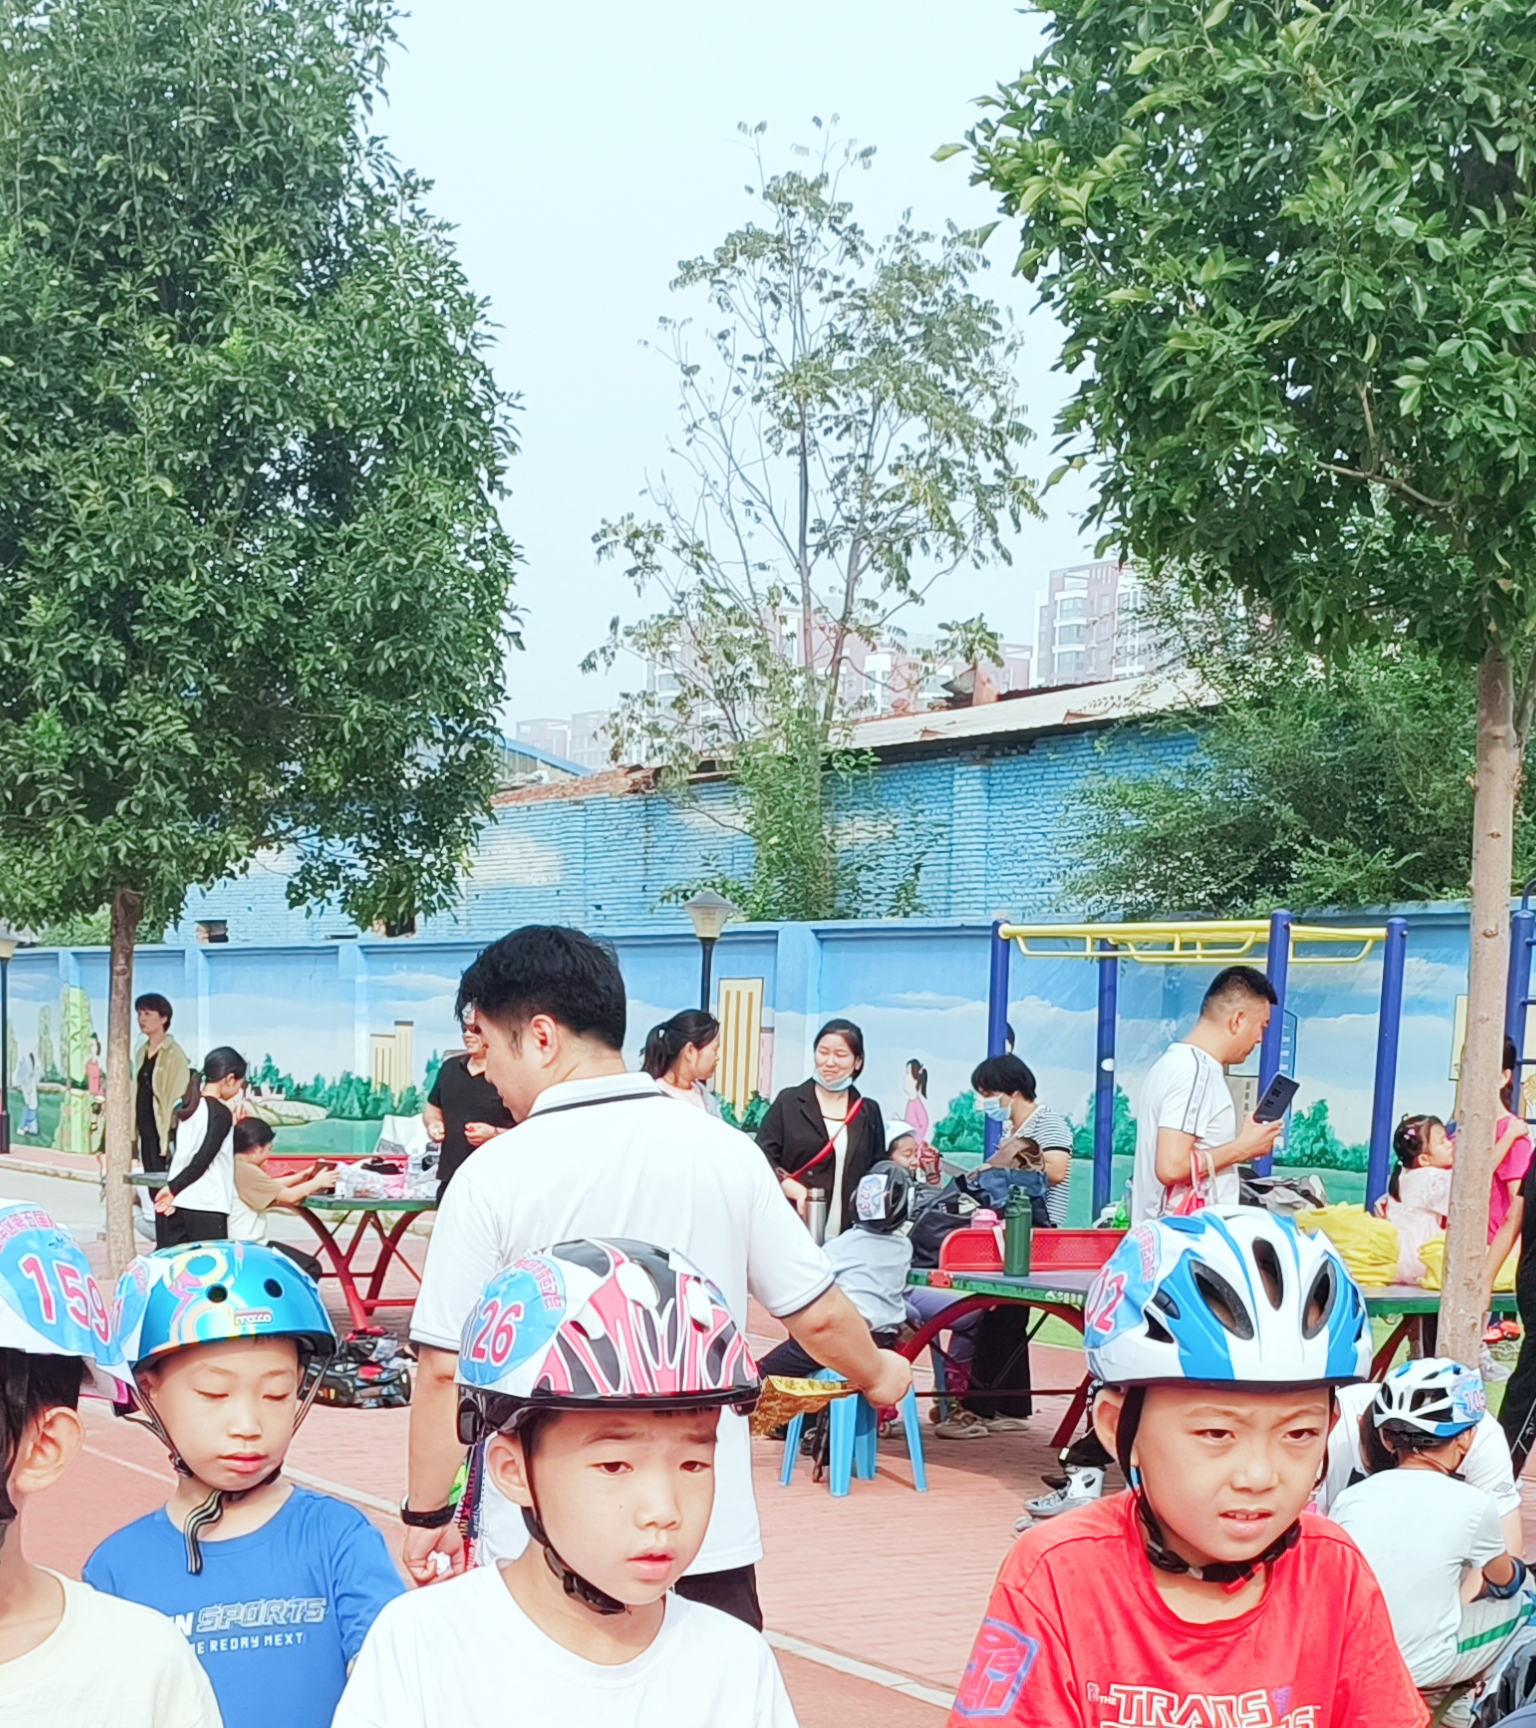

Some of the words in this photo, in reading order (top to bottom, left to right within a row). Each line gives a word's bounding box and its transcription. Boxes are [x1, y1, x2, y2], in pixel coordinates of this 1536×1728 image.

[20, 1256, 111, 1344] 159
[196, 1597, 327, 1633] SPORTS
[264, 1632, 304, 1647] NEXT
[1099, 1694, 1117, 1706] THE
